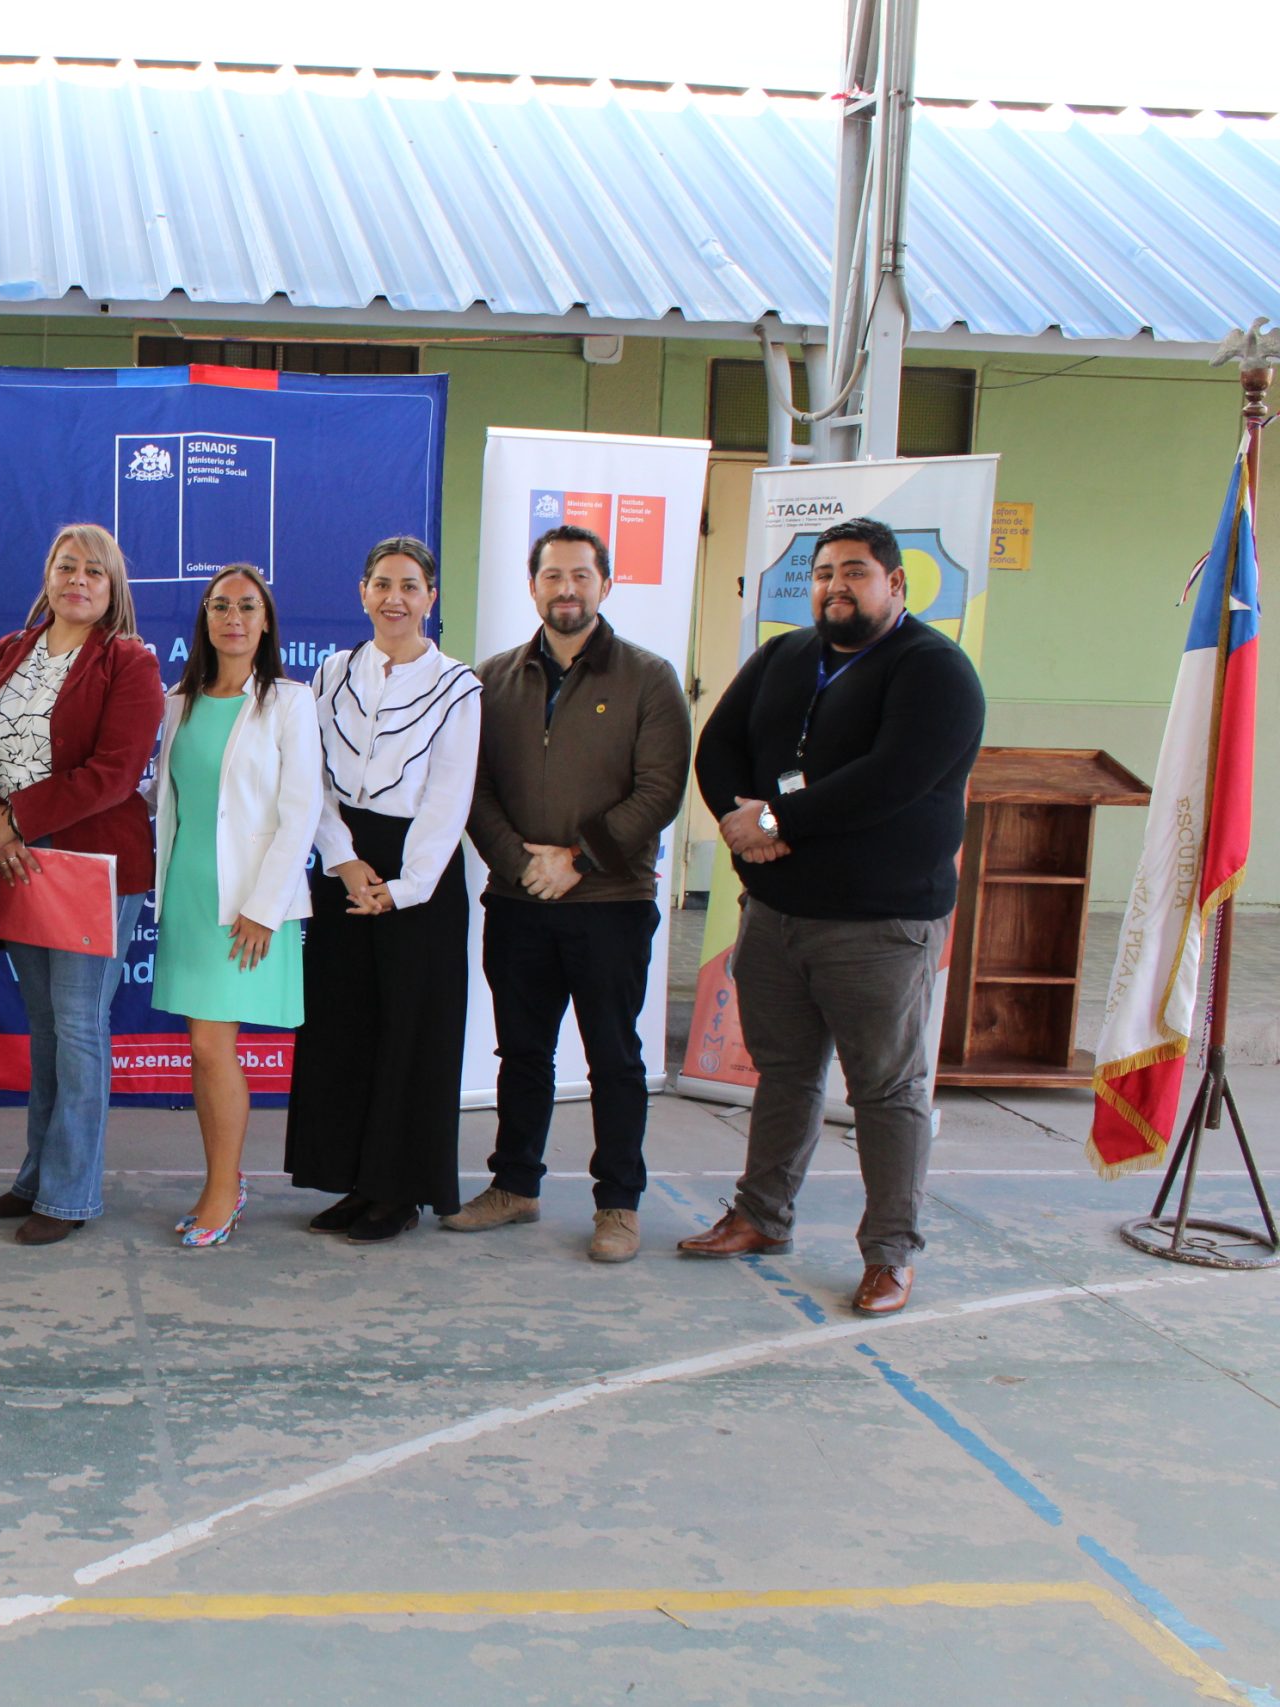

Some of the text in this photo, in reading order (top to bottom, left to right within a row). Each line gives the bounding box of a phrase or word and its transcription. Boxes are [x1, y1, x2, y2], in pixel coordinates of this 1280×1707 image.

[187, 442, 238, 455] SENADIS
[187, 456, 235, 466] Ministerio de
[187, 467, 247, 477] Desarrollo Social
[193, 475, 220, 484] Familia
[567, 500, 593, 508] Ministerio
[767, 502, 844, 516] ATACAMA
[566, 509, 588, 517] Deporte
[620, 507, 644, 515] Nacional
[620, 515, 644, 523] Deportes
[994, 536, 1007, 556] 5
[767, 587, 808, 598] LANZA
[1175, 796, 1196, 910] ESCUELA
